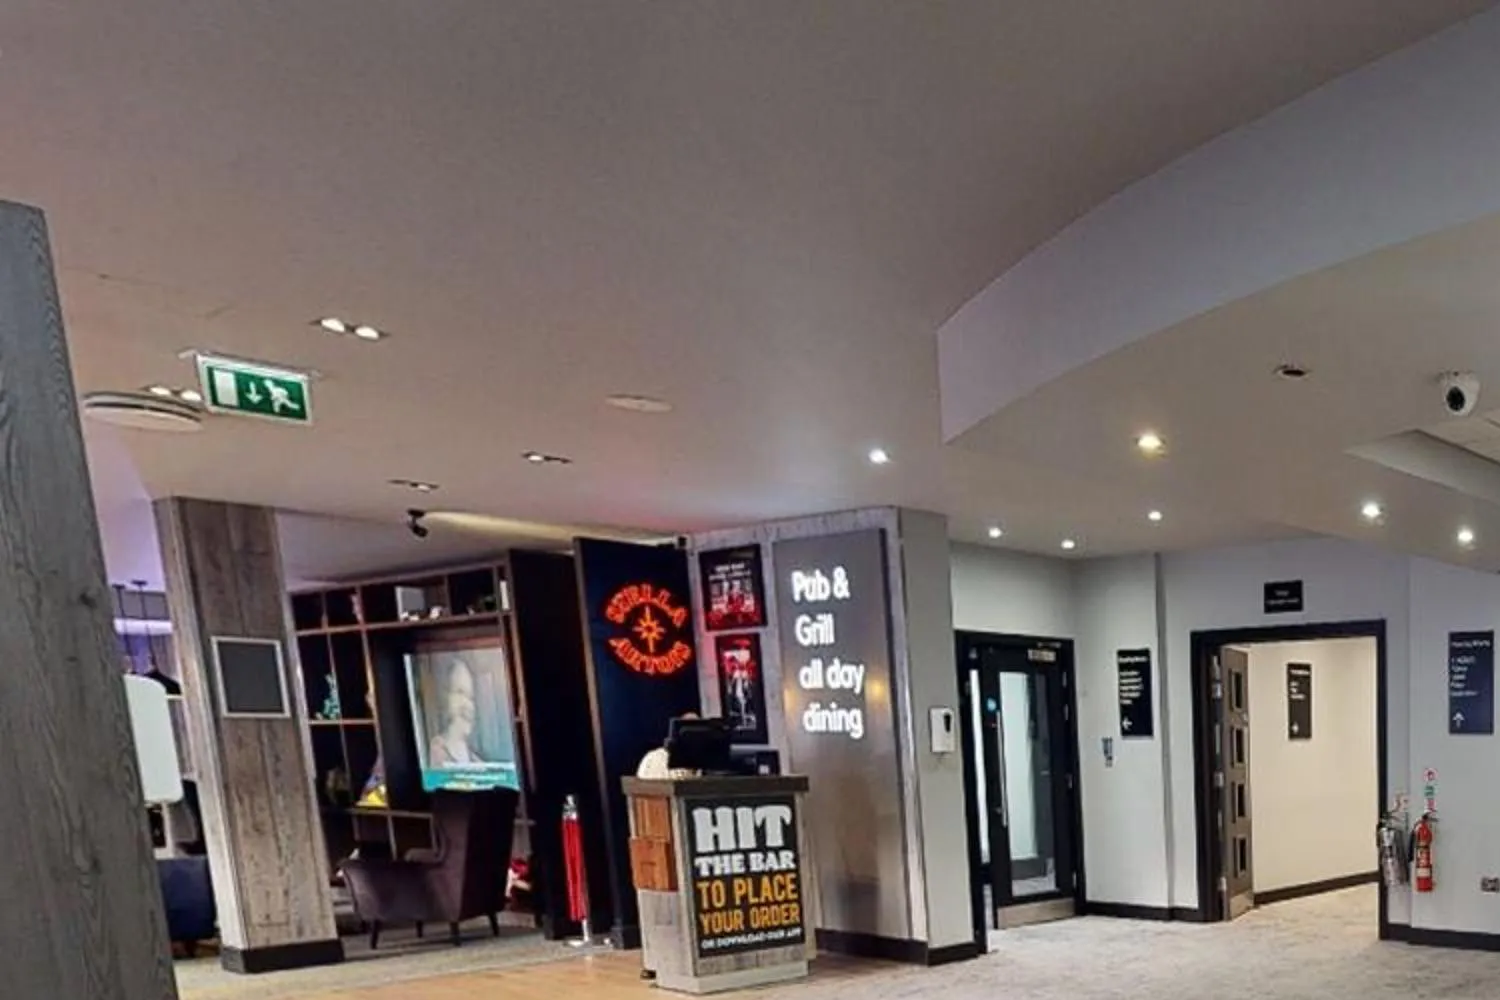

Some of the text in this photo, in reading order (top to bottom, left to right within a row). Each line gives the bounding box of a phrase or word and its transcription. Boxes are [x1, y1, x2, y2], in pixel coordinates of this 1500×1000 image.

[791, 566, 850, 601] Pub &
[795, 612, 836, 647] Grill
[799, 657, 866, 695] all day
[803, 701, 864, 740] dining
[692, 805, 792, 852] HIT
[695, 850, 796, 875] THE BAR
[697, 873, 799, 908] TO PLACE
[700, 903, 800, 935] YOUR ORDER
